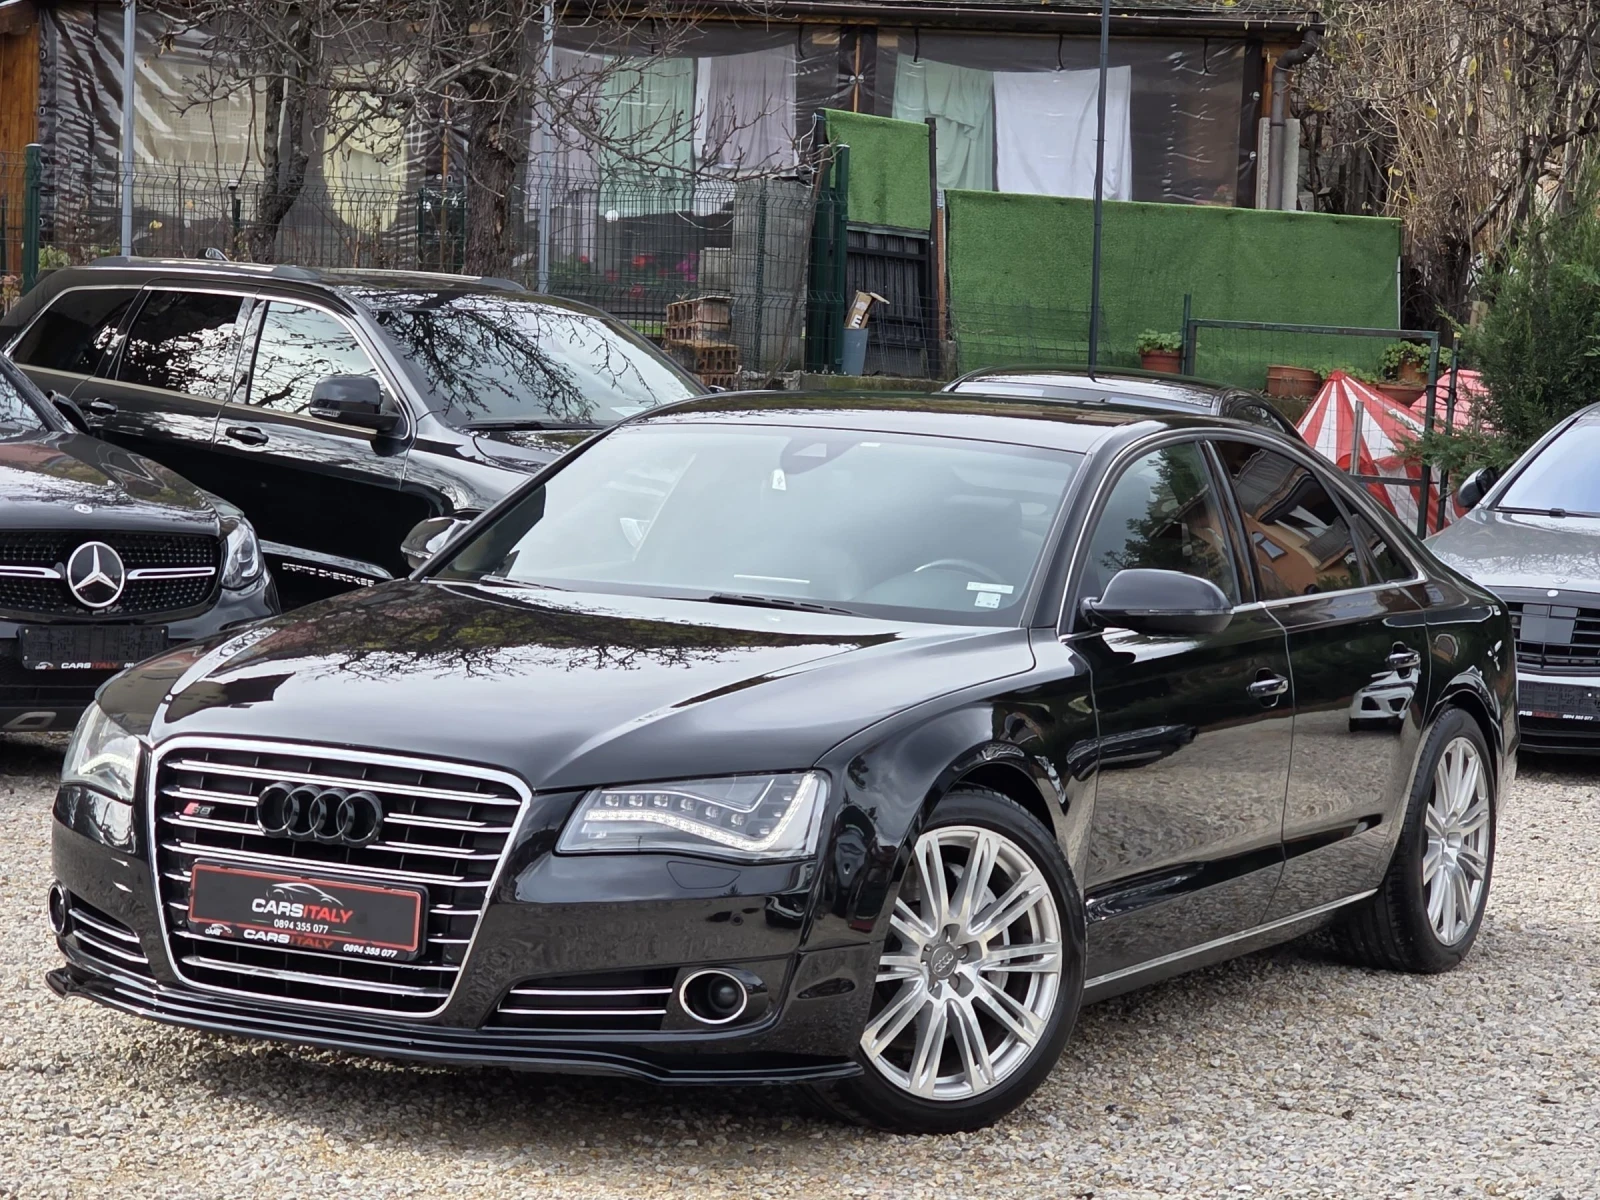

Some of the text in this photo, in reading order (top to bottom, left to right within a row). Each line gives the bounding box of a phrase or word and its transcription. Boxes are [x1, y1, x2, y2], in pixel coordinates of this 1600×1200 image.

[318, 569, 374, 587] CHEROKEE
[252, 898, 353, 924] CARSITALY
[274, 919, 329, 934] 0894 355 077
[243, 929, 334, 949] CARSITALY
[343, 943, 398, 958] 0894 355 077
